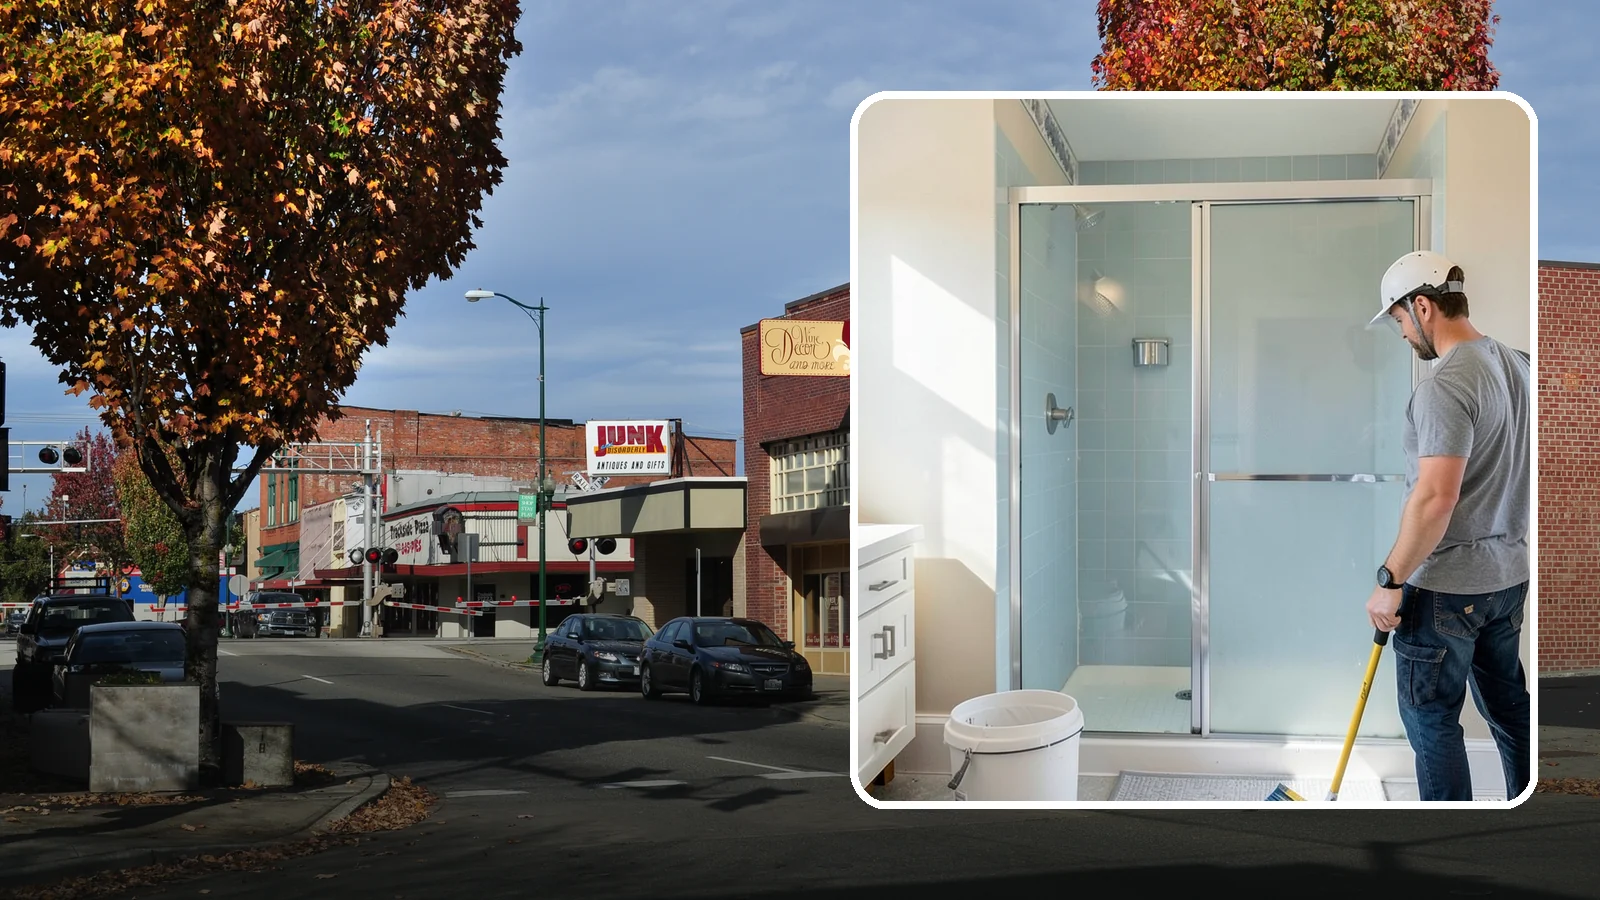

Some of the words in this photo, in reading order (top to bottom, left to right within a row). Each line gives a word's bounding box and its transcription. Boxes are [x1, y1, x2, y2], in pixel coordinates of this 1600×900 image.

[595, 425, 666, 457] JUNK
[607, 446, 646, 454] DISORDERLY
[597, 461, 628, 470] ANTIQUES
[631, 461, 644, 470] AND
[646, 460, 665, 470] GIFTS
[390, 521, 413, 540] Trackside
